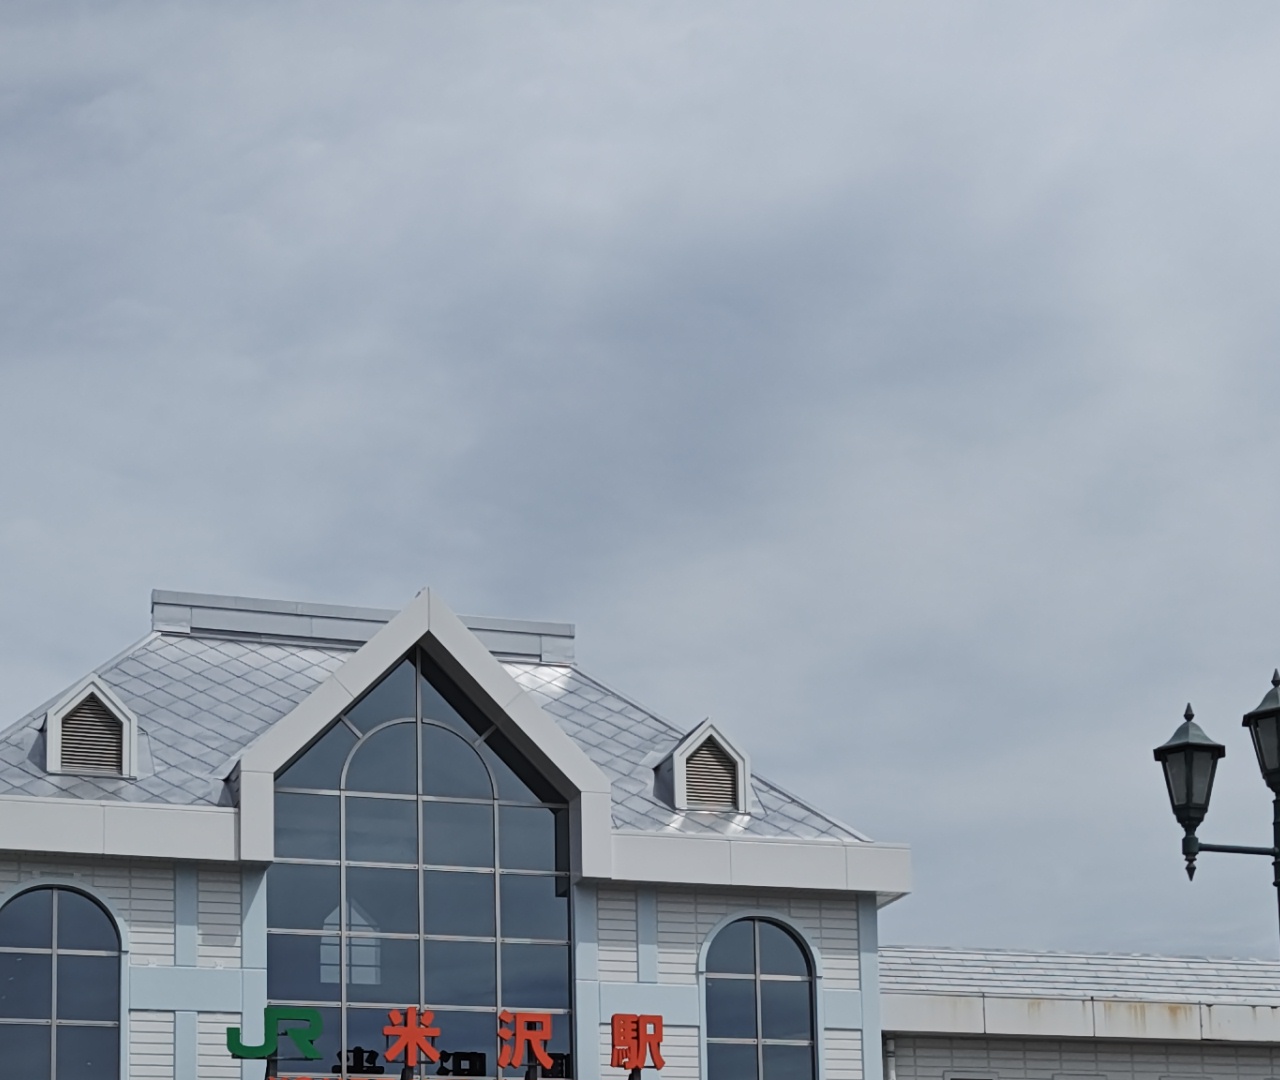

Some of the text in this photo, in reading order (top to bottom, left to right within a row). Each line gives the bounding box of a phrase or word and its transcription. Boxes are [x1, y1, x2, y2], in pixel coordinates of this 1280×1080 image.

[226, 1006, 323, 1059] JR
[382, 1006, 665, 1071] 米沢駅
